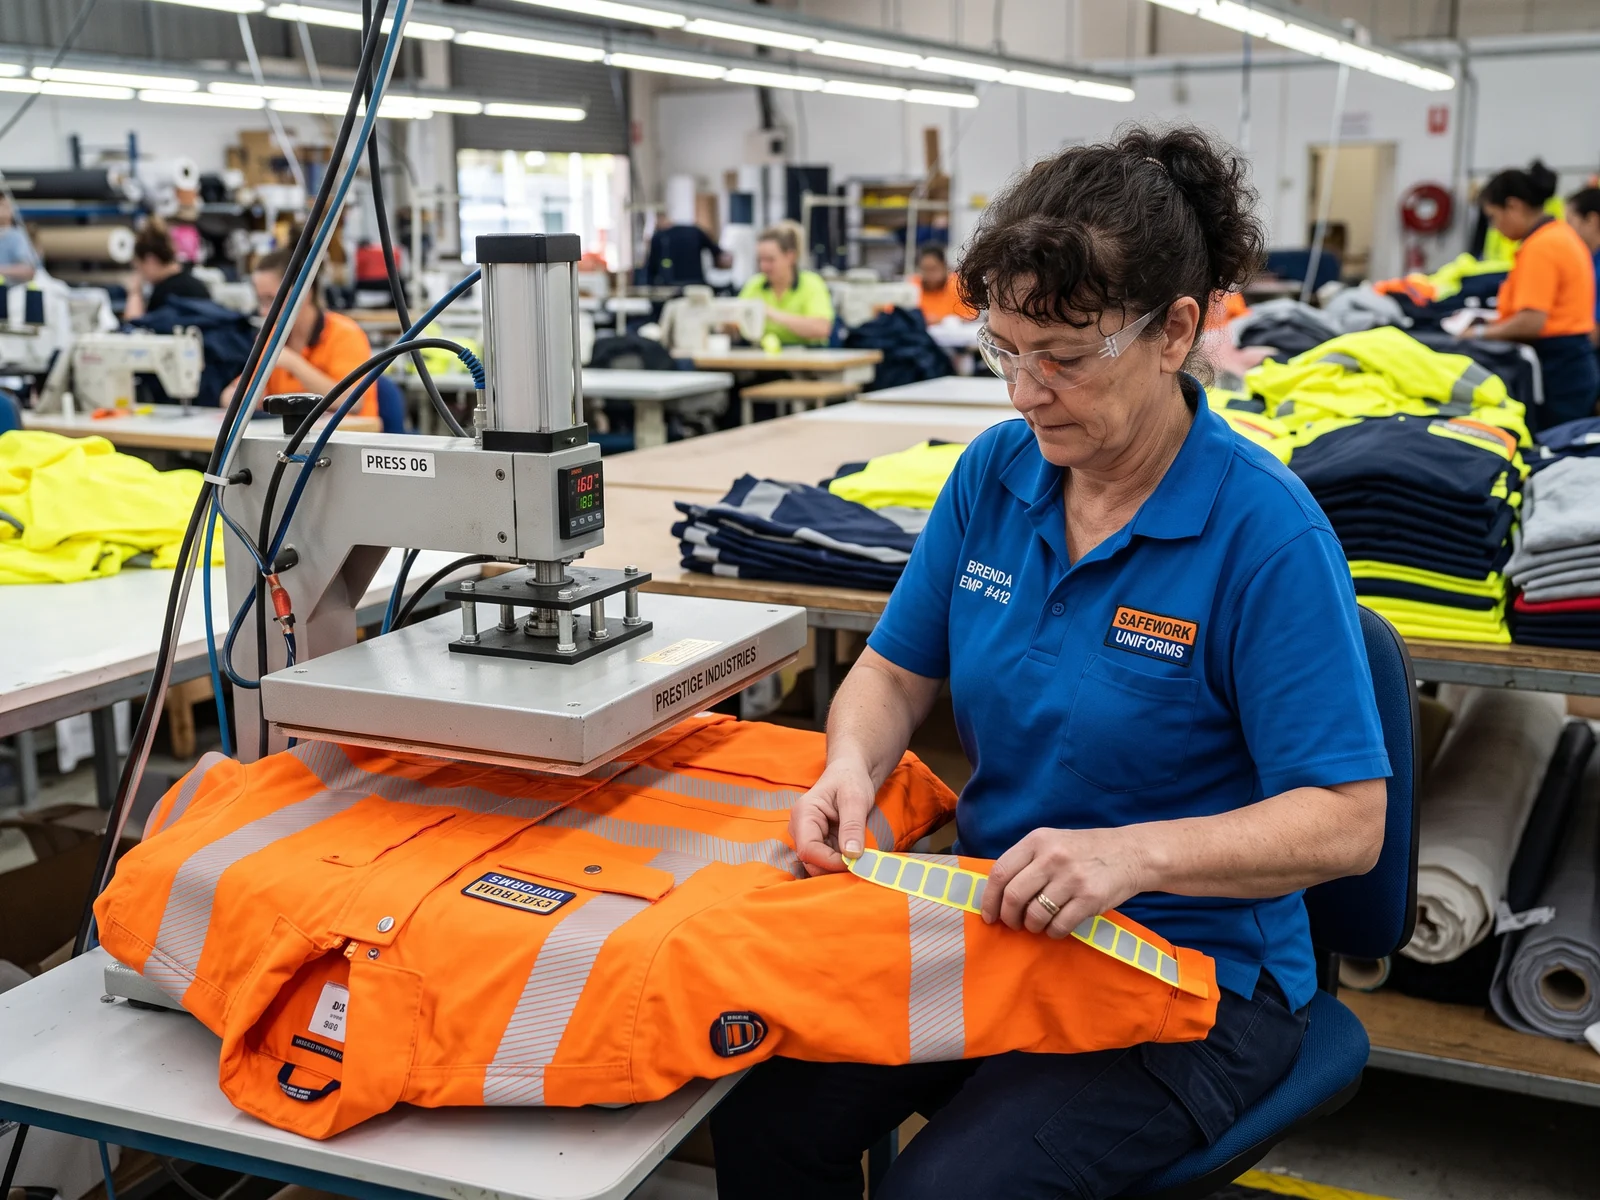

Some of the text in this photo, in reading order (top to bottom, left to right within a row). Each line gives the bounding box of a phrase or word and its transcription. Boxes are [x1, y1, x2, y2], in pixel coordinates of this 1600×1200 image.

[367, 455, 427, 472] PRESS 06
[577, 475, 593, 493] 160
[580, 494, 593, 509] 180
[966, 560, 1012, 588] BRENDA
[959, 575, 1011, 605] EMP #412
[1118, 612, 1192, 640] SAFEWORK
[1115, 630, 1185, 658] UNIFORMS
[656, 672, 703, 712] PRESTIGE
[705, 646, 757, 686] INDUSTRIES
